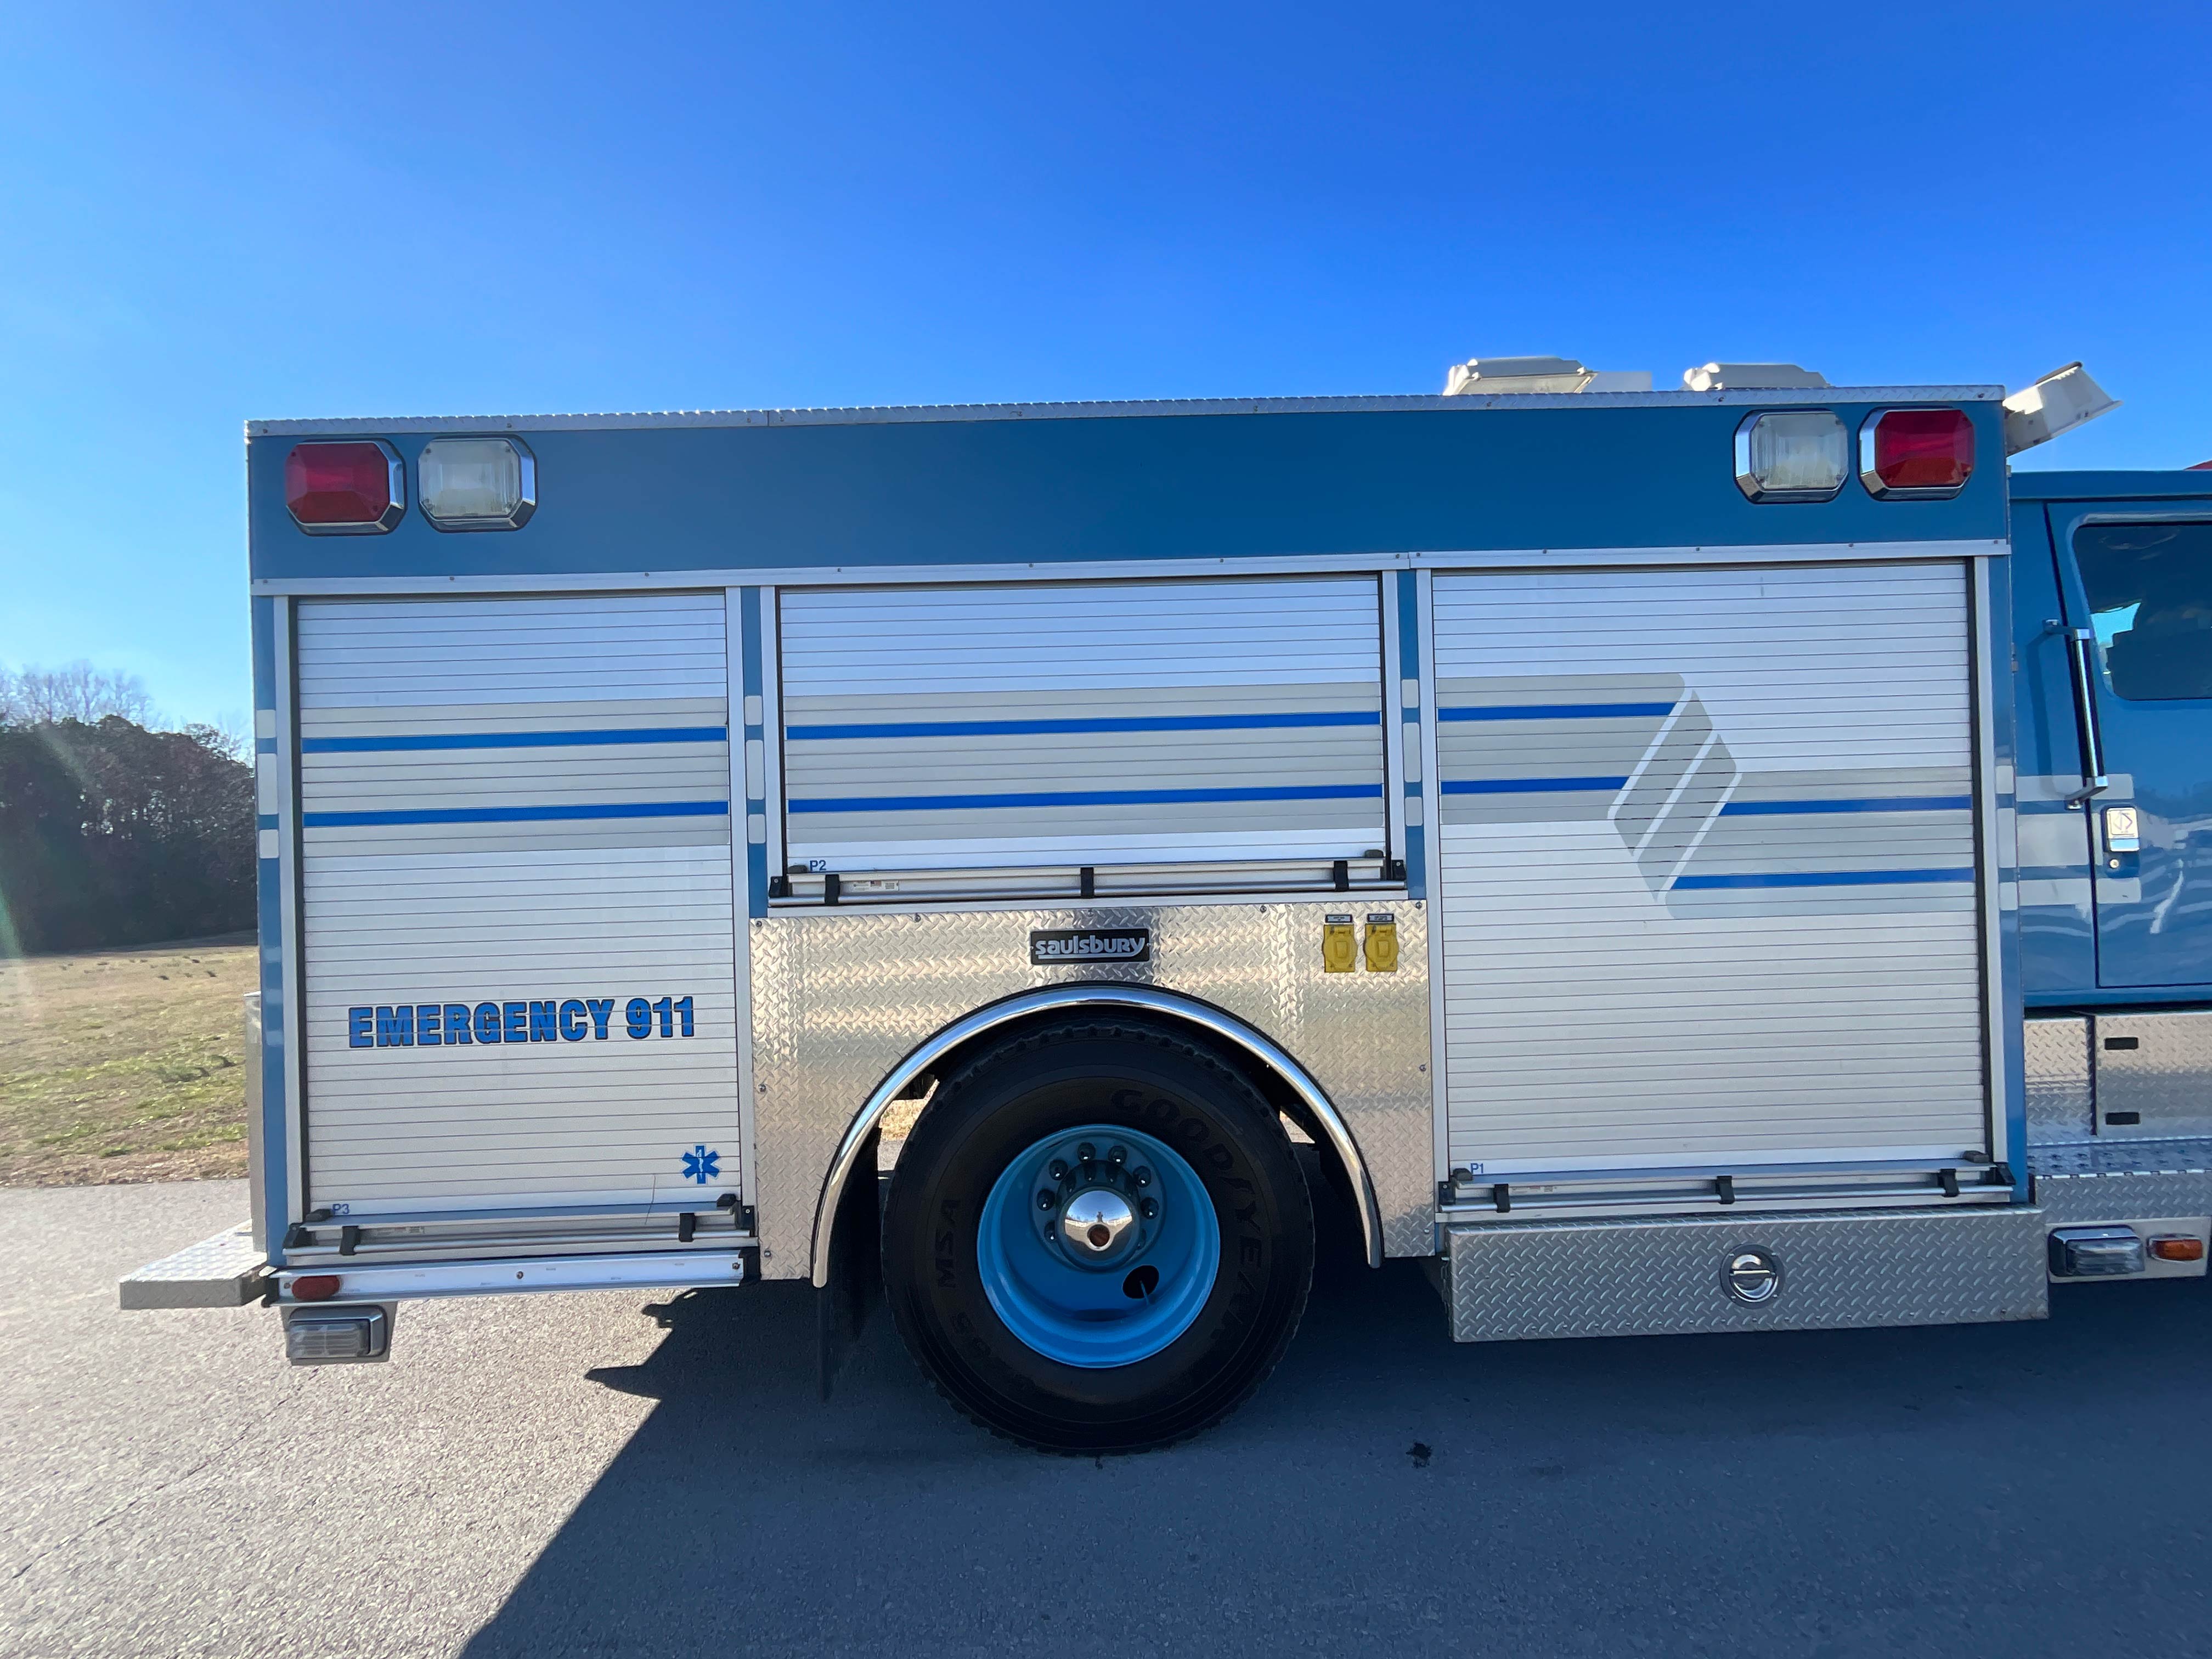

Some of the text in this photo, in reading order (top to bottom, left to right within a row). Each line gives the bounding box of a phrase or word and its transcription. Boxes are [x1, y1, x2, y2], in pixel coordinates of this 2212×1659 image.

[809, 860, 827, 871] P2
[348, 996, 695, 1048] EMERGENCY 911
[1470, 1163, 1483, 1174] P1
[332, 1203, 349, 1215] P3
[1110, 1088, 1262, 1338] GOODYEAR
[935, 1199, 961, 1289] MSA
